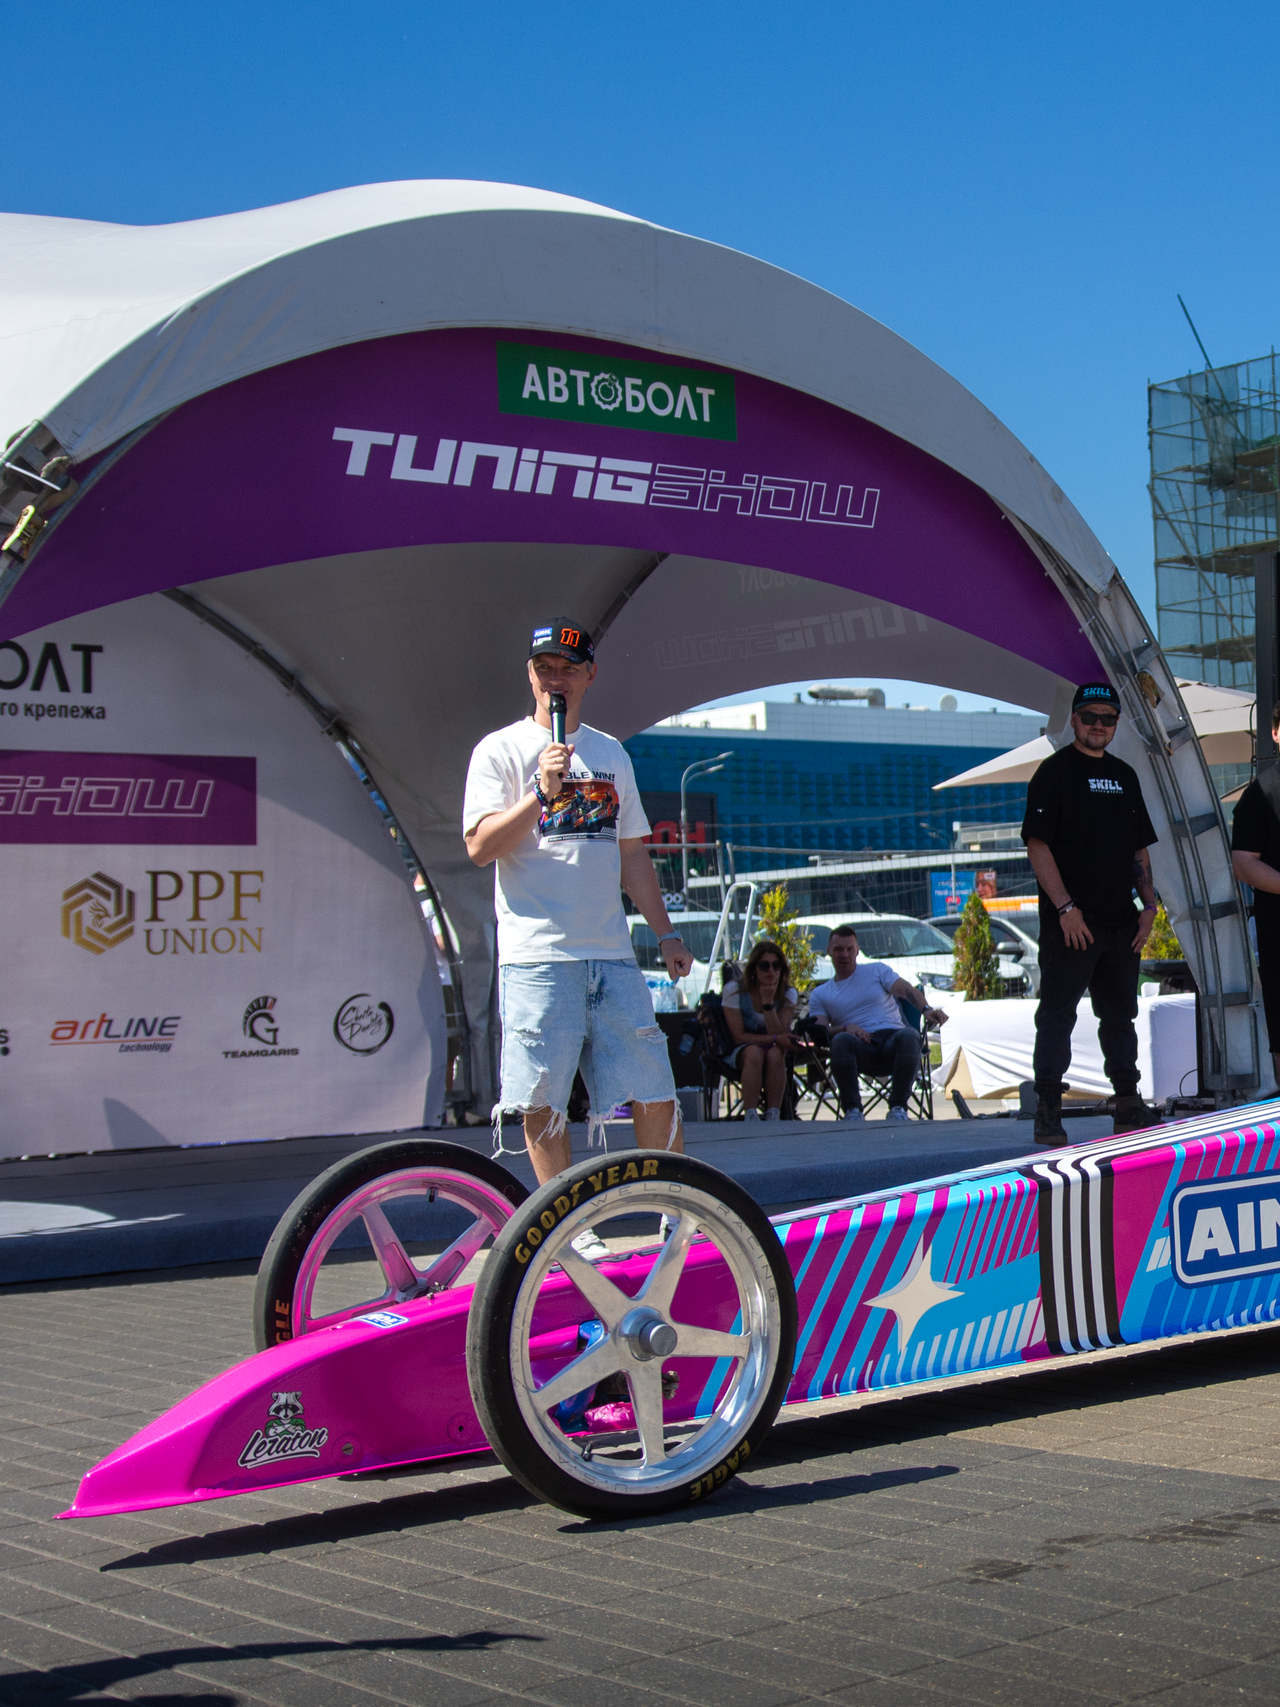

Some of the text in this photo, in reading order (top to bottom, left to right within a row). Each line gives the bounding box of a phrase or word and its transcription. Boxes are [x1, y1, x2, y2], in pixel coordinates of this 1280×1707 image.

[522, 364, 715, 423] АВТОБОЛТ
[560, 628, 580, 647] 11
[1083, 687, 1111, 697] SKILL
[23, 703, 106, 721] крепежа
[534, 771, 590, 780] DBLE
[1087, 778, 1123, 791] SKILL
[144, 870, 265, 922] PPF
[144, 927, 265, 955] UNION
[119, 1041, 173, 1053] technology
[222, 1048, 300, 1059] TEAMGARIS
[515, 1159, 660, 1264] GOODYEAR
[590, 1182, 778, 1303] WELD RACING
[275, 1299, 290, 1345] GLE
[690, 1439, 751, 1501] EAGLE
